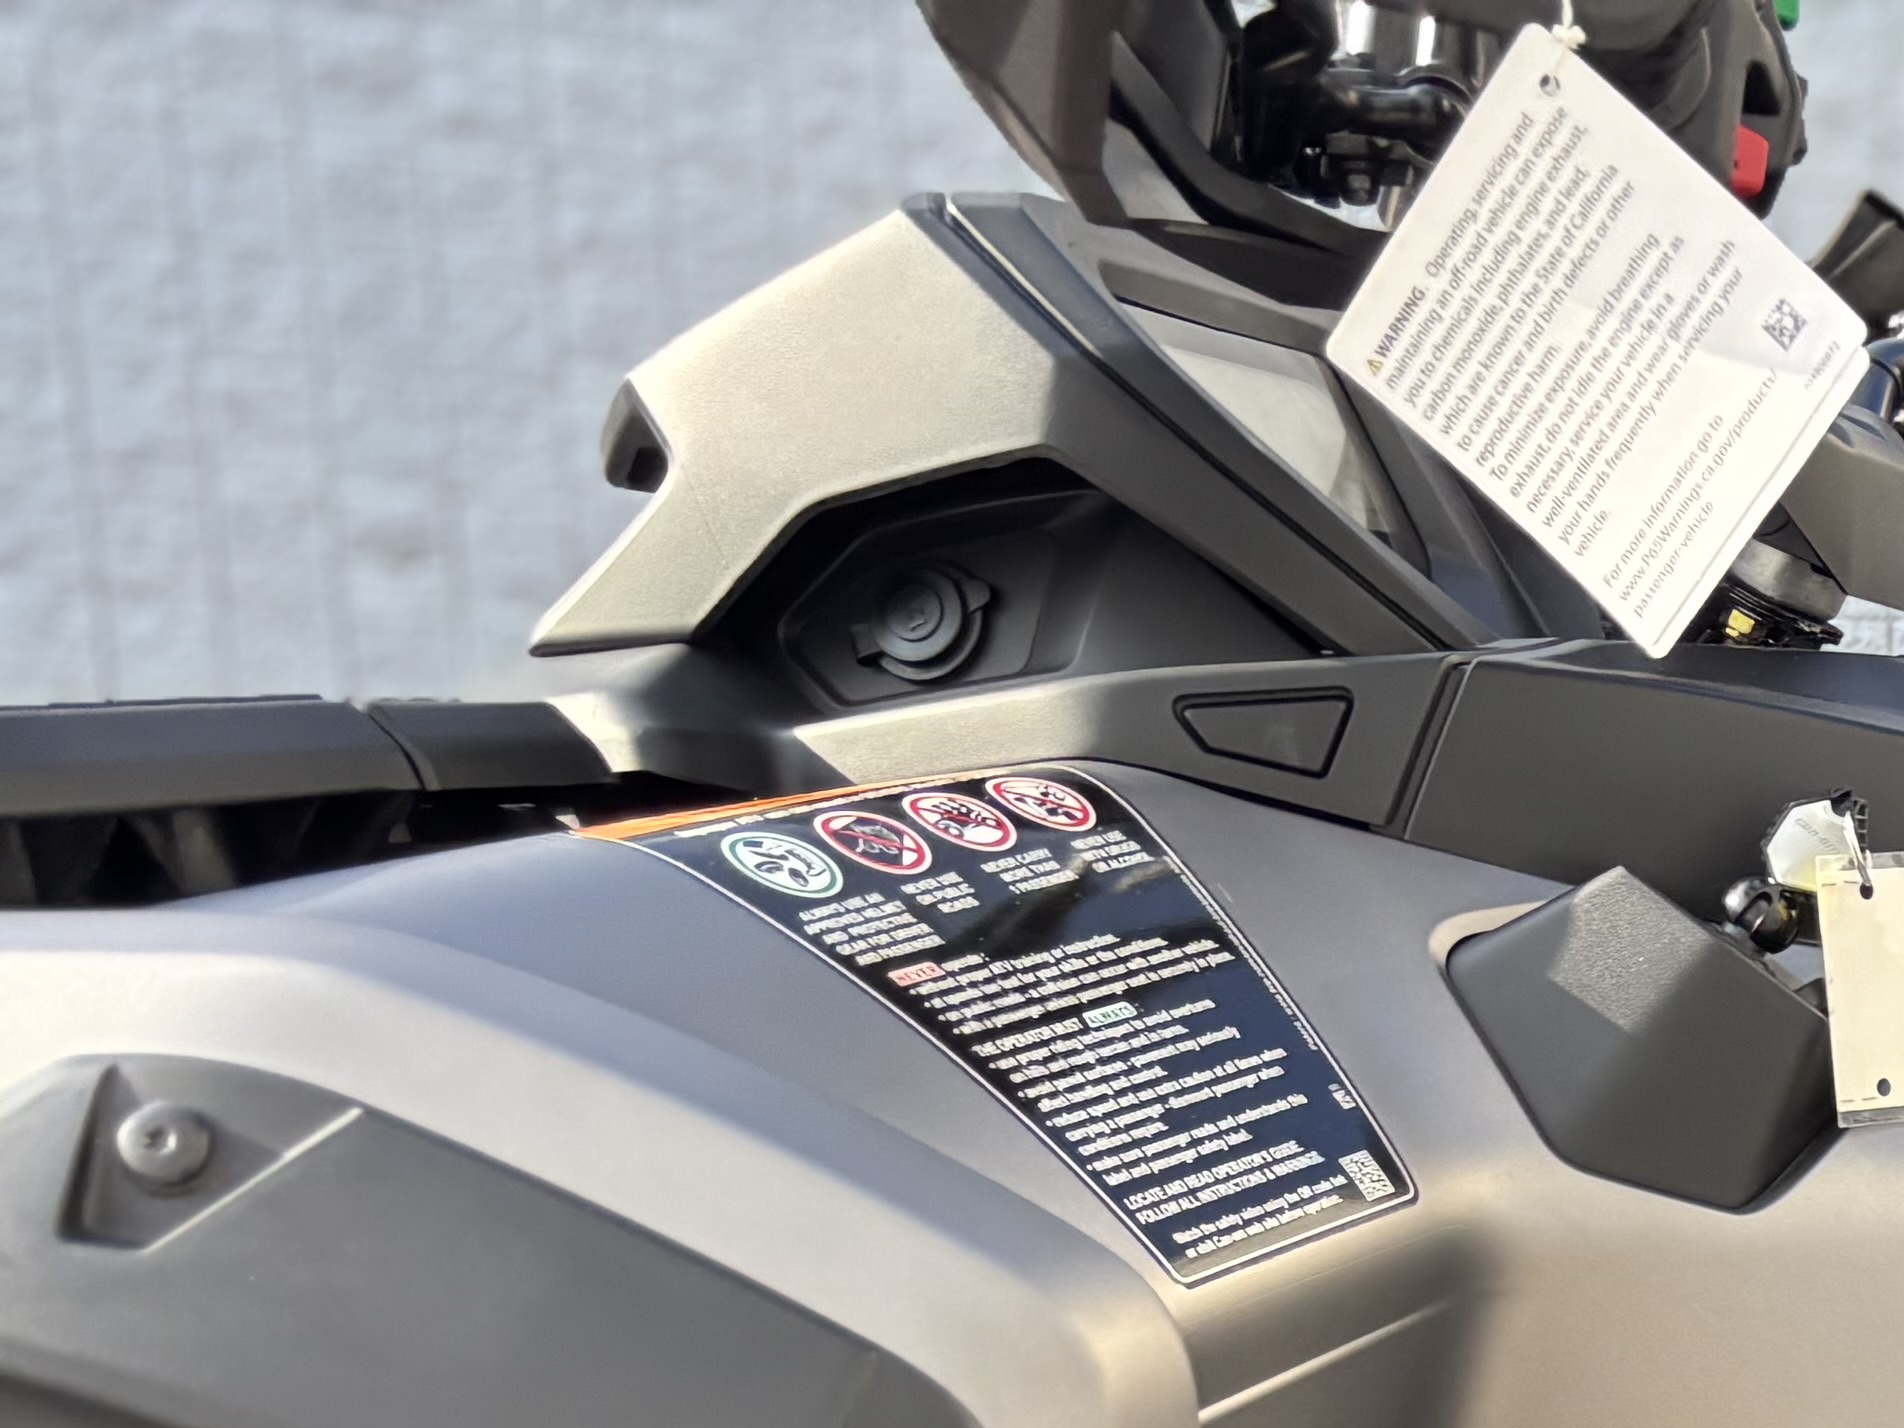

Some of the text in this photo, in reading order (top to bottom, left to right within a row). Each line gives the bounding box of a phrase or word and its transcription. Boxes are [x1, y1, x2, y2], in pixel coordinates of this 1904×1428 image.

[1468, 139, 1519, 210] servicing
[1506, 110, 1536, 147] and
[1510, 176, 1554, 236] engine
[1381, 304, 1444, 394] maintaining
[1433, 286, 1455, 312] an
[1478, 179, 1521, 238] vehicle
[1512, 155, 1537, 188] can
[1528, 103, 1572, 164] expose
[1469, 224, 1523, 300] including
[1695, 274, 1713, 297] or
[1703, 235, 1737, 280] wash
[1417, 367, 1459, 424] carbon
[1539, 195, 1568, 232] and
[1427, 289, 1480, 363] chemicals
[1435, 158, 1620, 439] which are known to the State of California
[1455, 176, 1637, 455] to cause cancer and birth defects or other
[1663, 290, 1703, 344] gloves
[1419, 358, 1437, 380] to
[1488, 458, 1510, 484] To
[1501, 398, 1549, 466] minimize
[1581, 296, 1616, 342] avoid
[1606, 228, 1661, 305] breathing
[1541, 418, 1563, 445] do
[1556, 394, 1579, 424] not
[1571, 367, 1597, 400] idle
[1588, 342, 1613, 374] the
[1604, 294, 1646, 351] engine
[1636, 250, 1676, 303] except
[1668, 233, 1685, 254] as
[1566, 395, 1605, 449] service
[1599, 364, 1629, 404] your
[1617, 314, 1658, 370] vehicle
[1648, 298, 1668, 322] in
[1661, 290, 1675, 306] a
[1642, 335, 1671, 375] wear
[1402, 374, 1429, 409] you
[1472, 377, 1537, 471] reproductive
[1557, 266, 1747, 546] your hands frequently when servicing your
[1604, 398, 1630, 433] area
[1622, 370, 1649, 403] and
